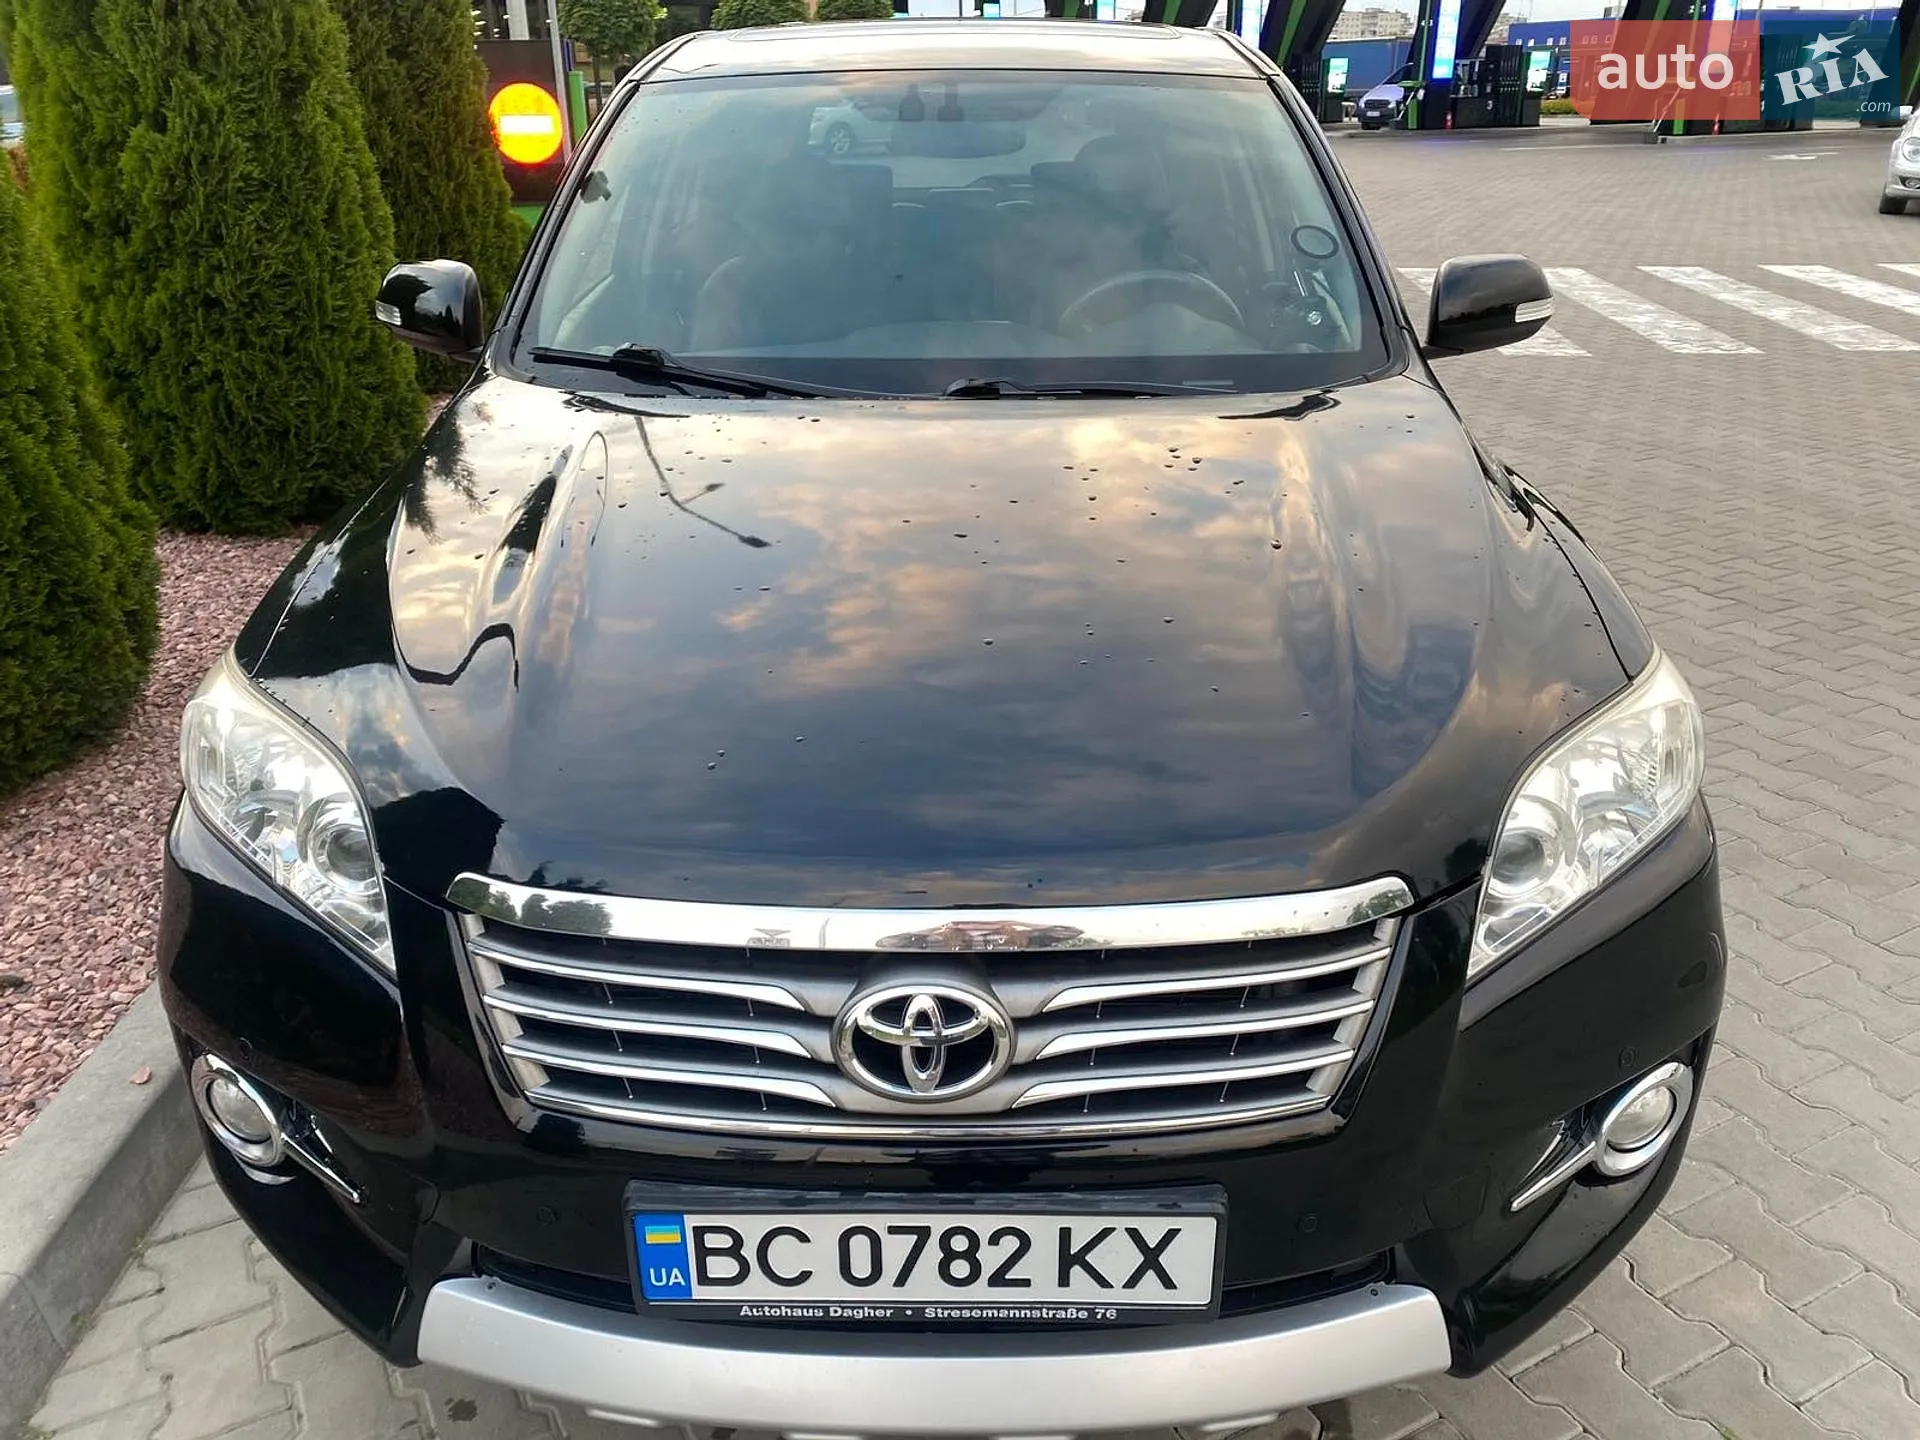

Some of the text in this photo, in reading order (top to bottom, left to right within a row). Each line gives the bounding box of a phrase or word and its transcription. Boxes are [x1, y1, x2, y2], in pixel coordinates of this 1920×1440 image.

[692, 1225, 1182, 1290] BC 0782 KX
[650, 1268, 686, 1287] UA
[739, 1305, 1118, 1320] Autohaus Dagher Stresemannstraße 76
